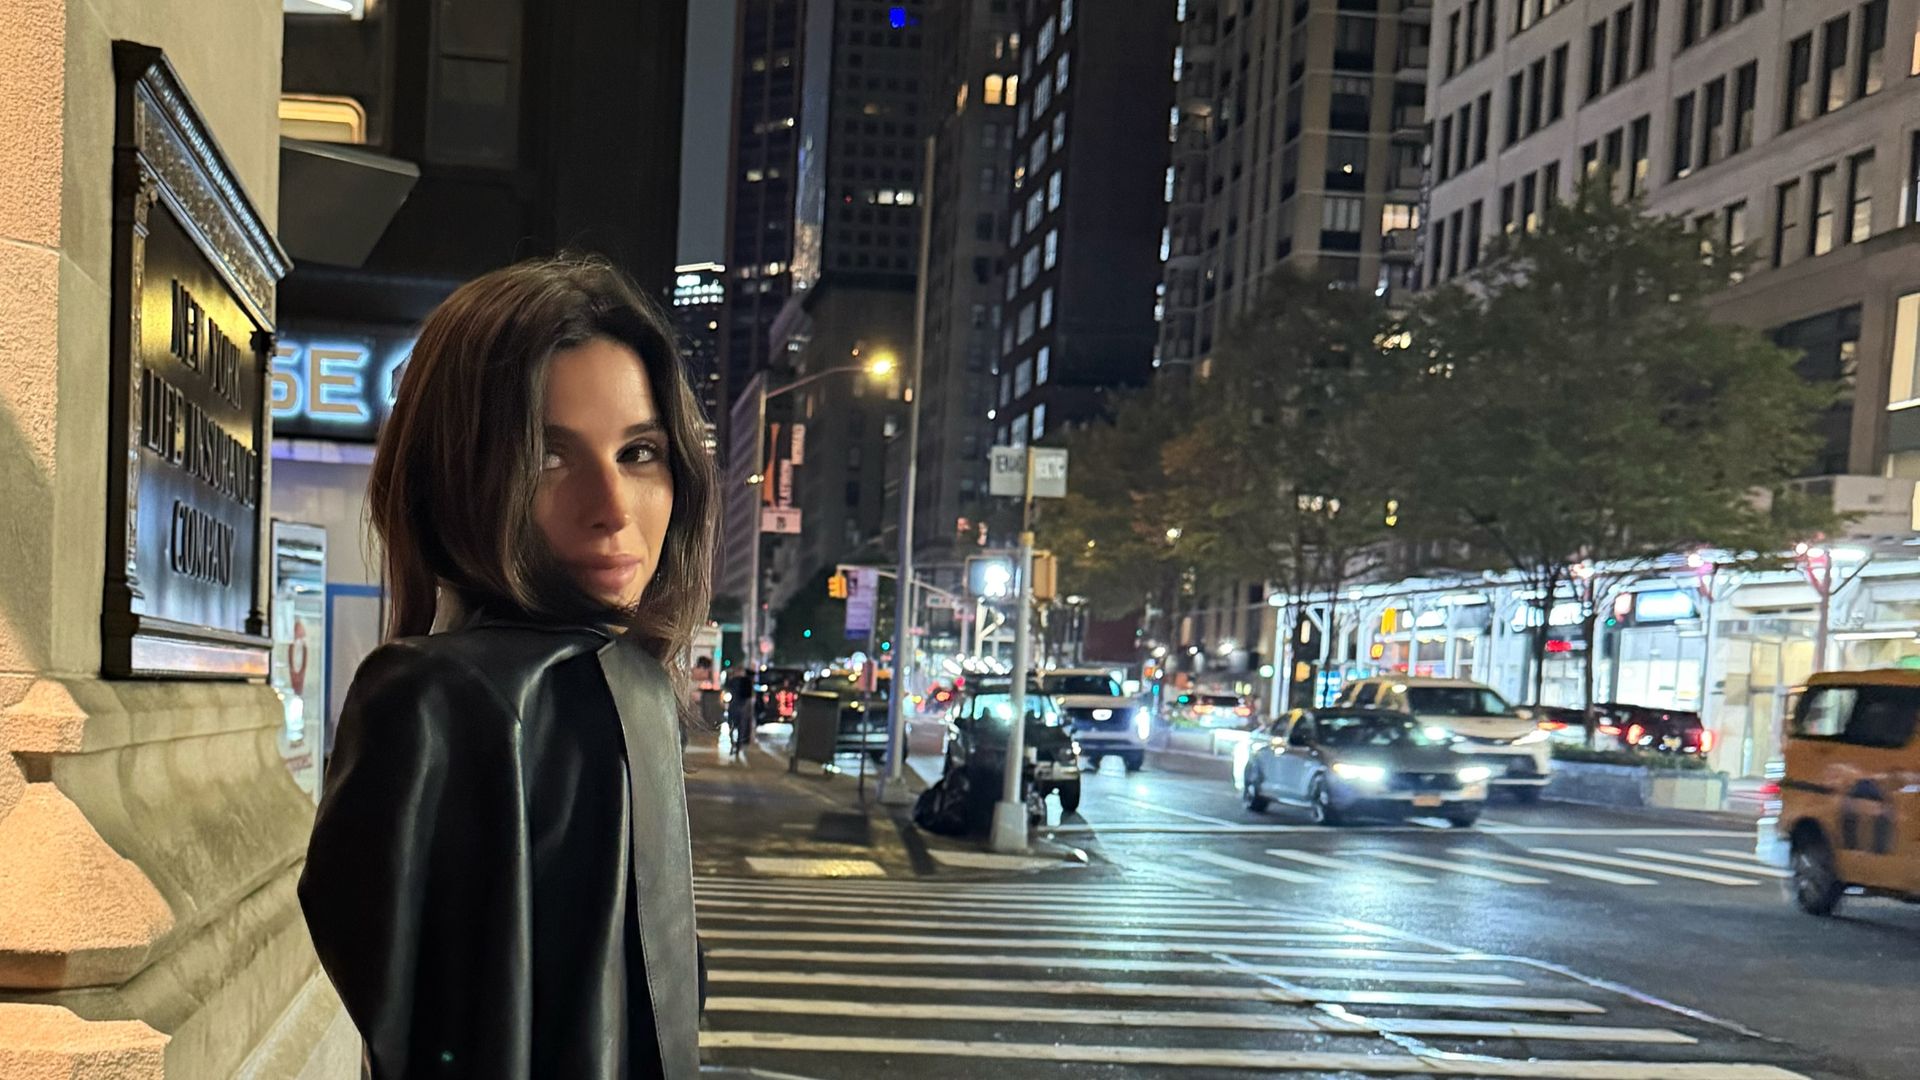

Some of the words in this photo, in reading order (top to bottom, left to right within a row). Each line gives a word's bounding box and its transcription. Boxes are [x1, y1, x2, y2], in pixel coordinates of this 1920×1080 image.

[171, 278, 205, 376] NEW
[208, 316, 242, 411] YORK
[142, 367, 185, 466] LIFE
[186, 400, 258, 511] INSURANCE
[171, 497, 236, 589] COMPANY
